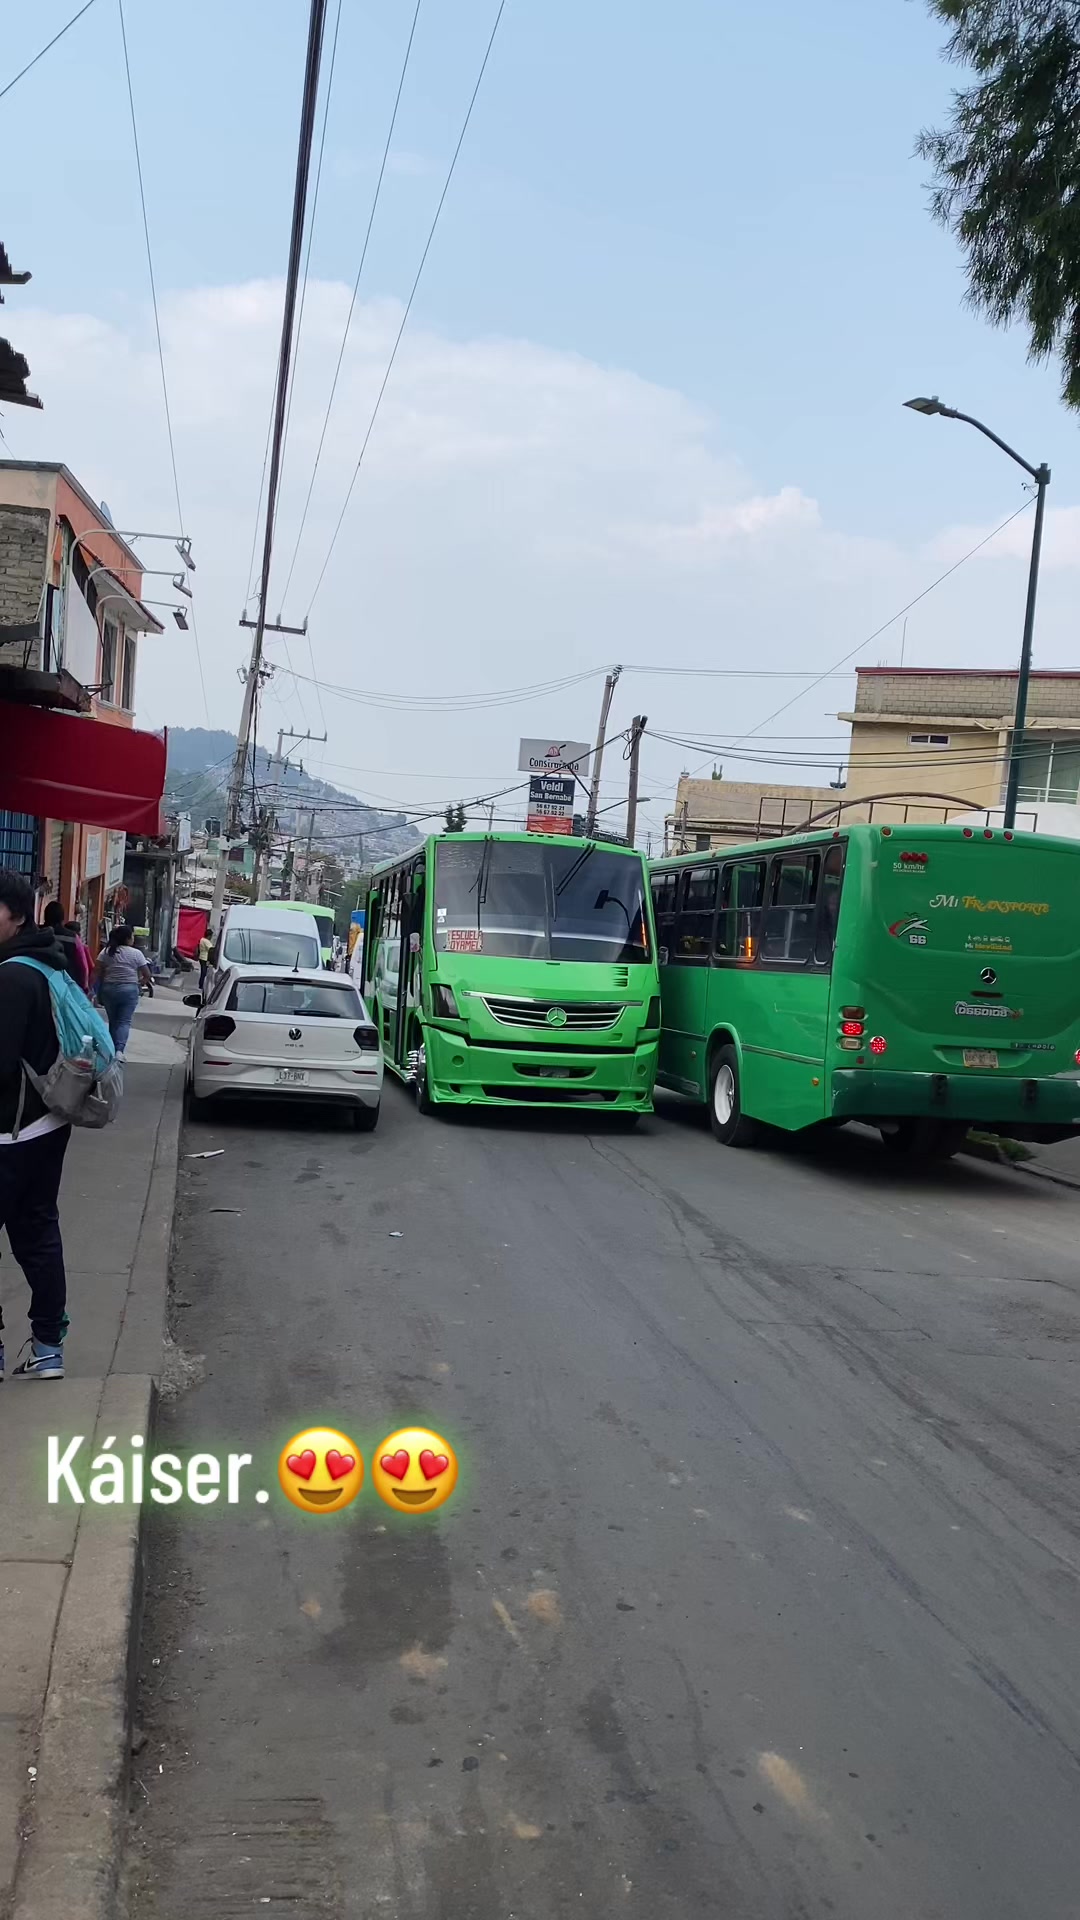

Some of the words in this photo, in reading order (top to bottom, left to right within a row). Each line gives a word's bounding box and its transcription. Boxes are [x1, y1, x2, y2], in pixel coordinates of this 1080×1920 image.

[530, 791, 543, 799] San
[903, 862, 925, 870] km/hr
[909, 934, 927, 945] 66
